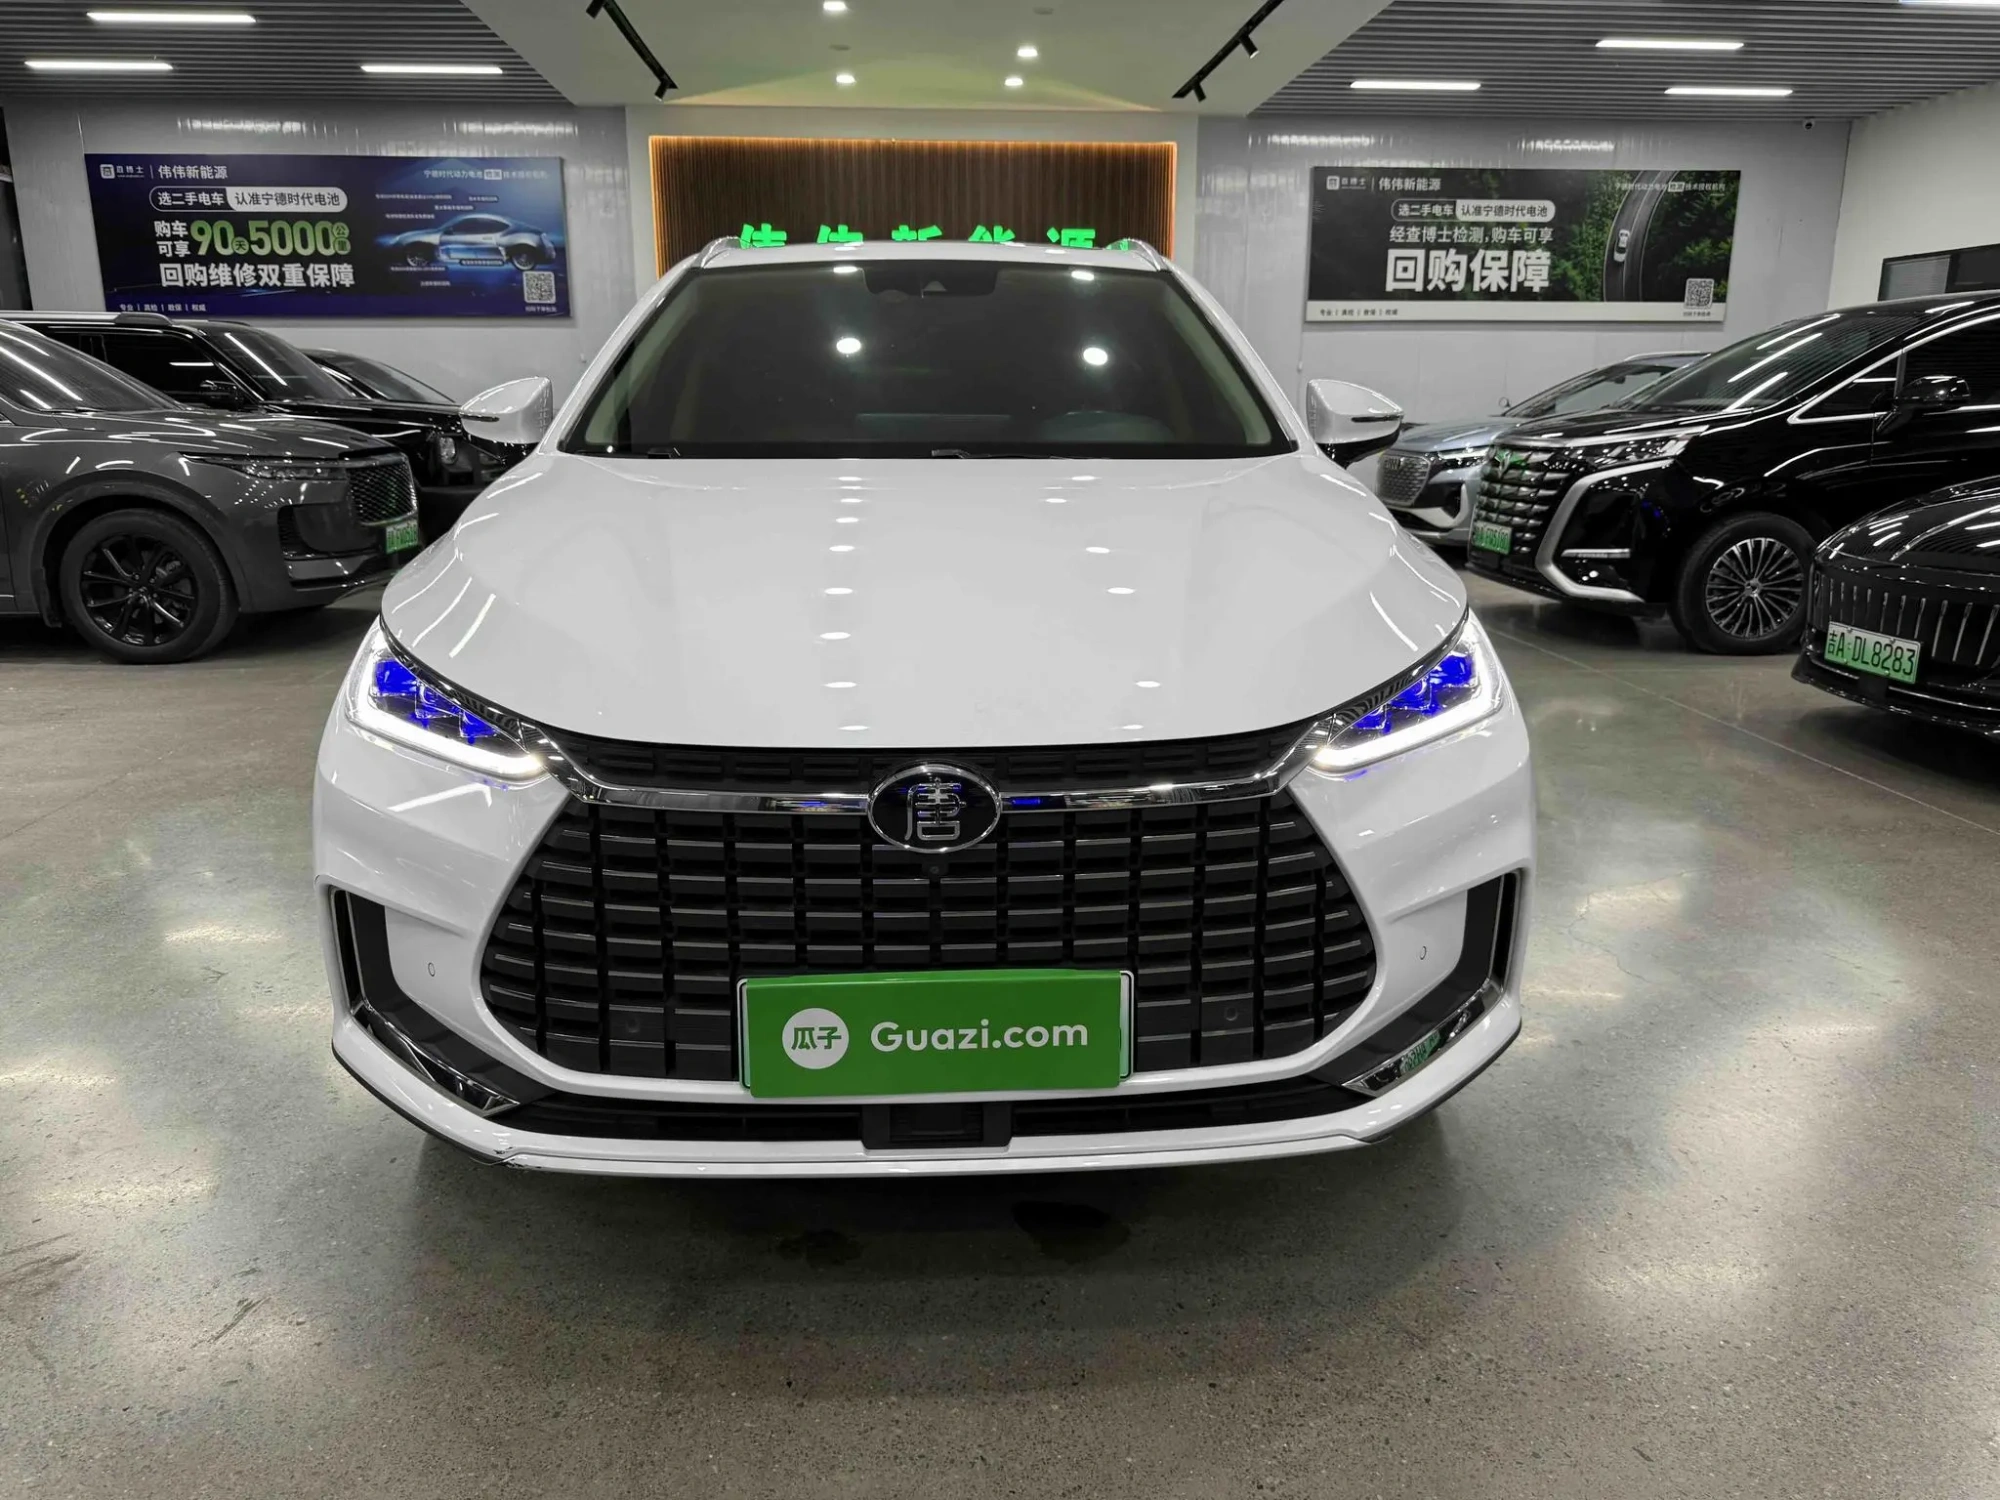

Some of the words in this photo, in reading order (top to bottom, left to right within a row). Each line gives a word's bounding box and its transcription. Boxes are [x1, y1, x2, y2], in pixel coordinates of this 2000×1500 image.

[158, 165, 228, 180] 伟伟新能源
[1378, 177, 1441, 191] 伟伟新能源
[157, 192, 225, 206] 选二手电车
[235, 192, 340, 206] 认准宁德时代电池
[1398, 203, 1454, 216] 选二手电车
[1461, 205, 1548, 217] 认准宁德时代电池
[154, 220, 188, 237] 购车
[156, 240, 191, 257] 可享
[159, 263, 355, 288] 回购维修双重保障
[1385, 248, 1551, 293] 回购保障
[791, 1026, 842, 1051] 瓜子
[870, 1019, 1088, 1053] Guazi.com
